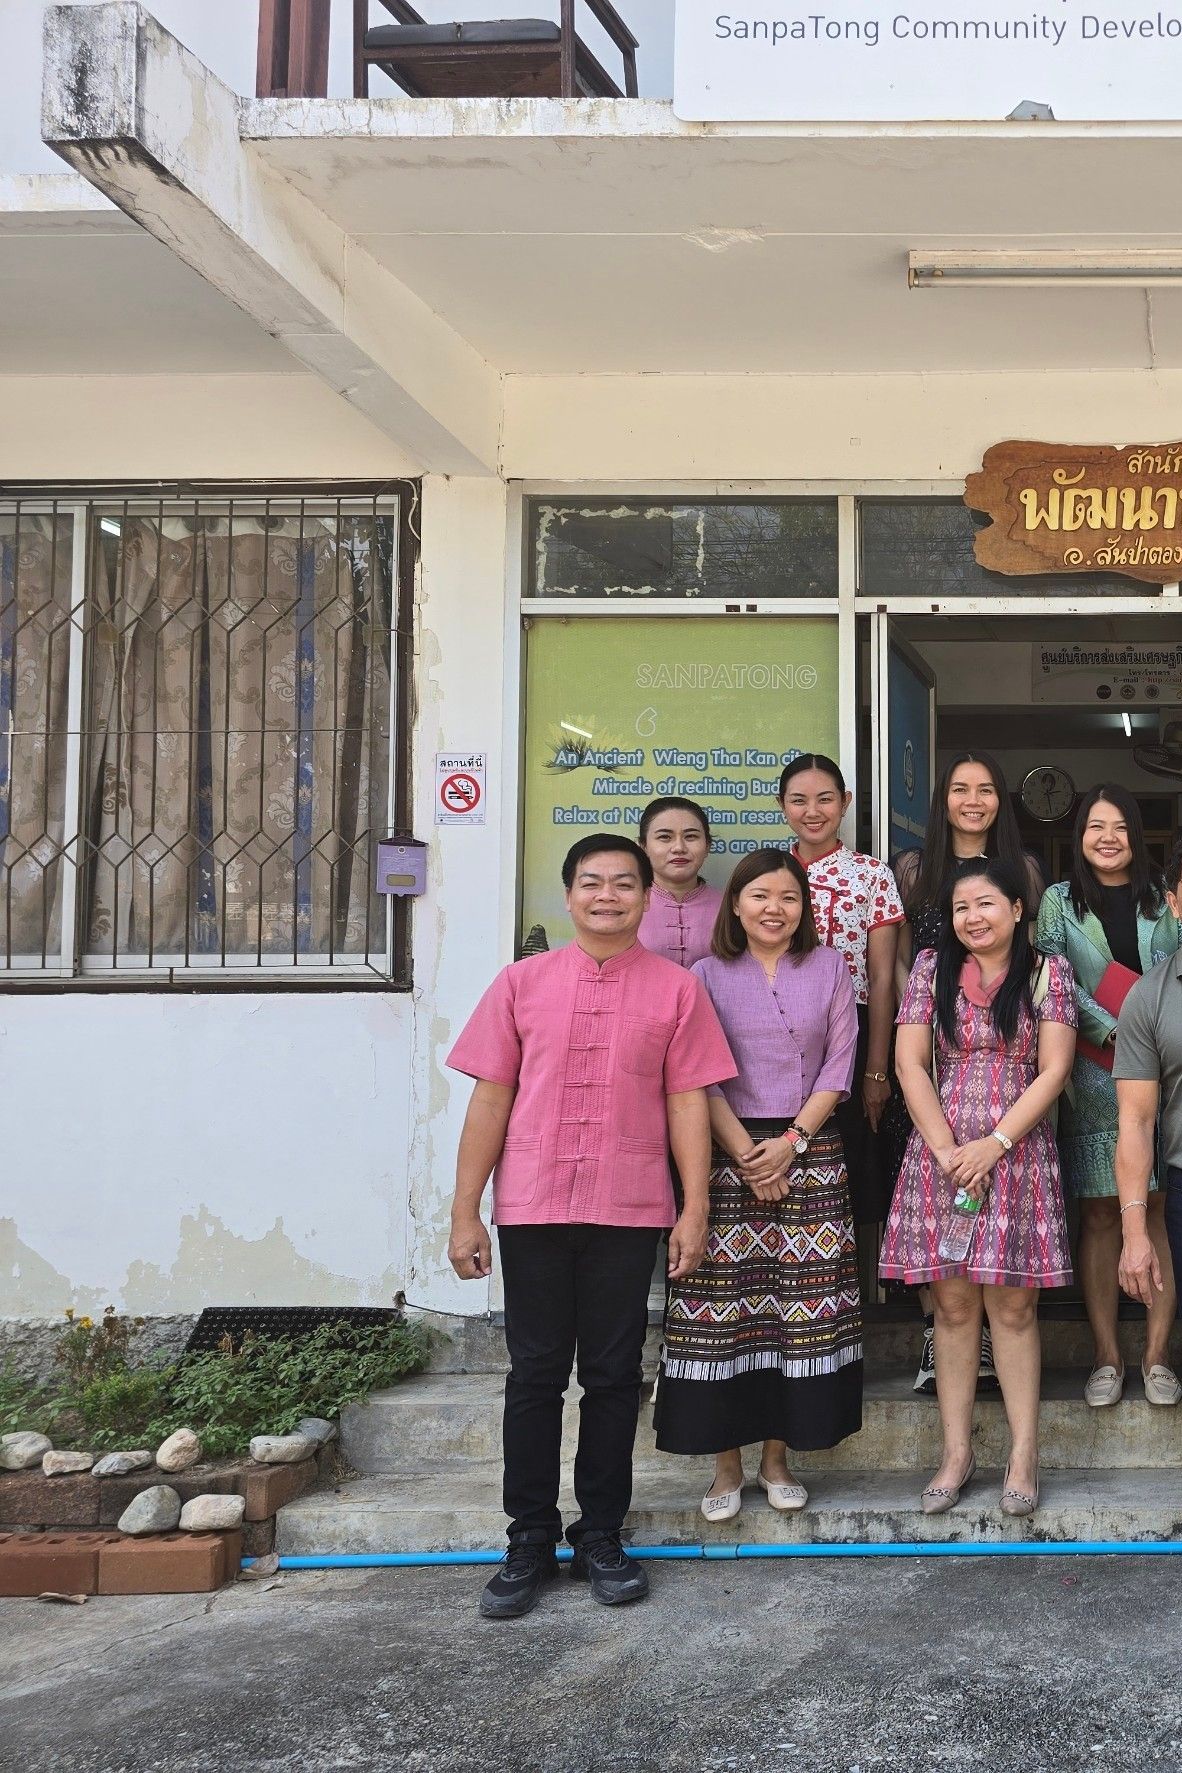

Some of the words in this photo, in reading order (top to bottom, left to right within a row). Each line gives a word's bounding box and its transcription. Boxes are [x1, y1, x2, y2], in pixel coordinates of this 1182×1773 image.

[714, 14, 880, 47] SanpaTong
[892, 12, 1067, 47] Community
[635, 663, 818, 690] SANPATONG
[439, 754, 483, 768] สถานที่นี้
[555, 749, 578, 766] An
[582, 748, 643, 766] Ancient
[653, 748, 707, 771] Wieng
[711, 748, 741, 766] Tha
[745, 749, 777, 766] Kan
[592, 777, 653, 795] Miracle
[656, 777, 676, 795] of
[680, 777, 748, 800] reclining
[553, 805, 599, 823] Relax
[602, 807, 621, 823] at
[730, 840, 758, 853] are
